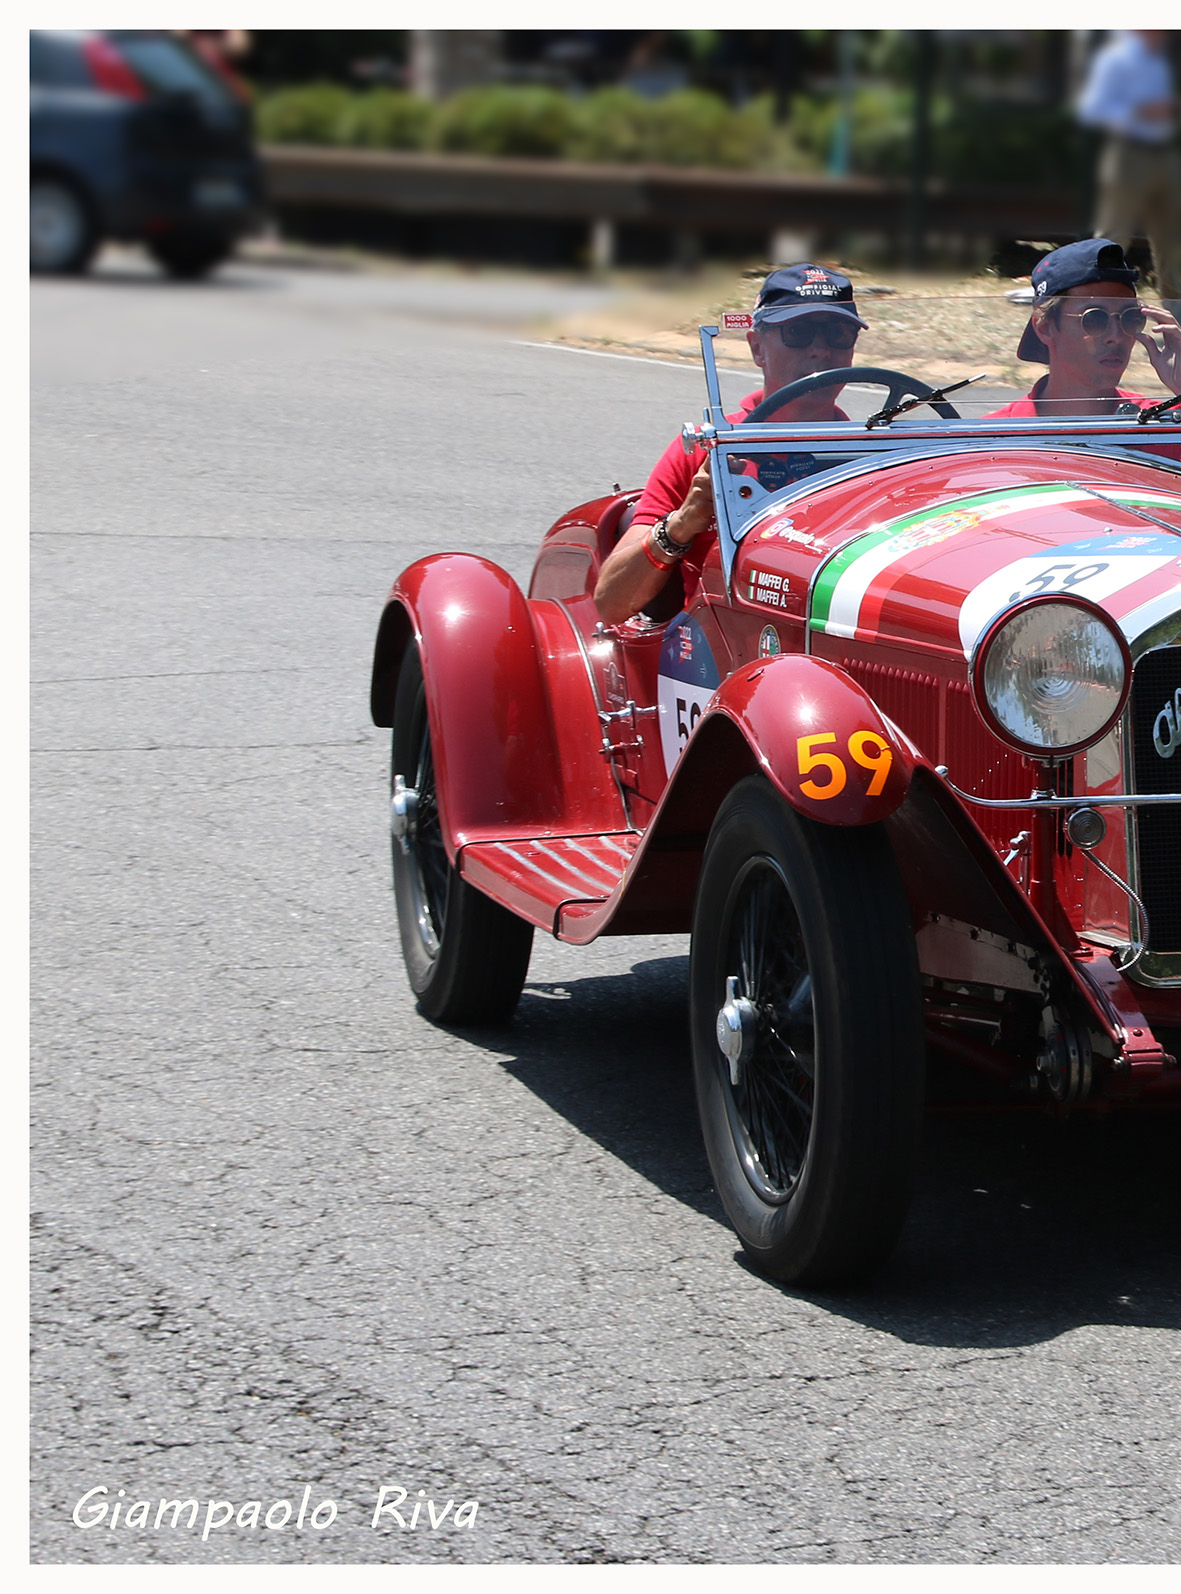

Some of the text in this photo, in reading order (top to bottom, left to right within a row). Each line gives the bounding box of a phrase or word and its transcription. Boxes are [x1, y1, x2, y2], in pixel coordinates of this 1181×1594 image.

[757, 572, 790, 592] MAFFEI G.
[1009, 563, 1110, 602] 59
[756, 587, 788, 608] MAFFEI A.
[796, 730, 893, 800] 59
